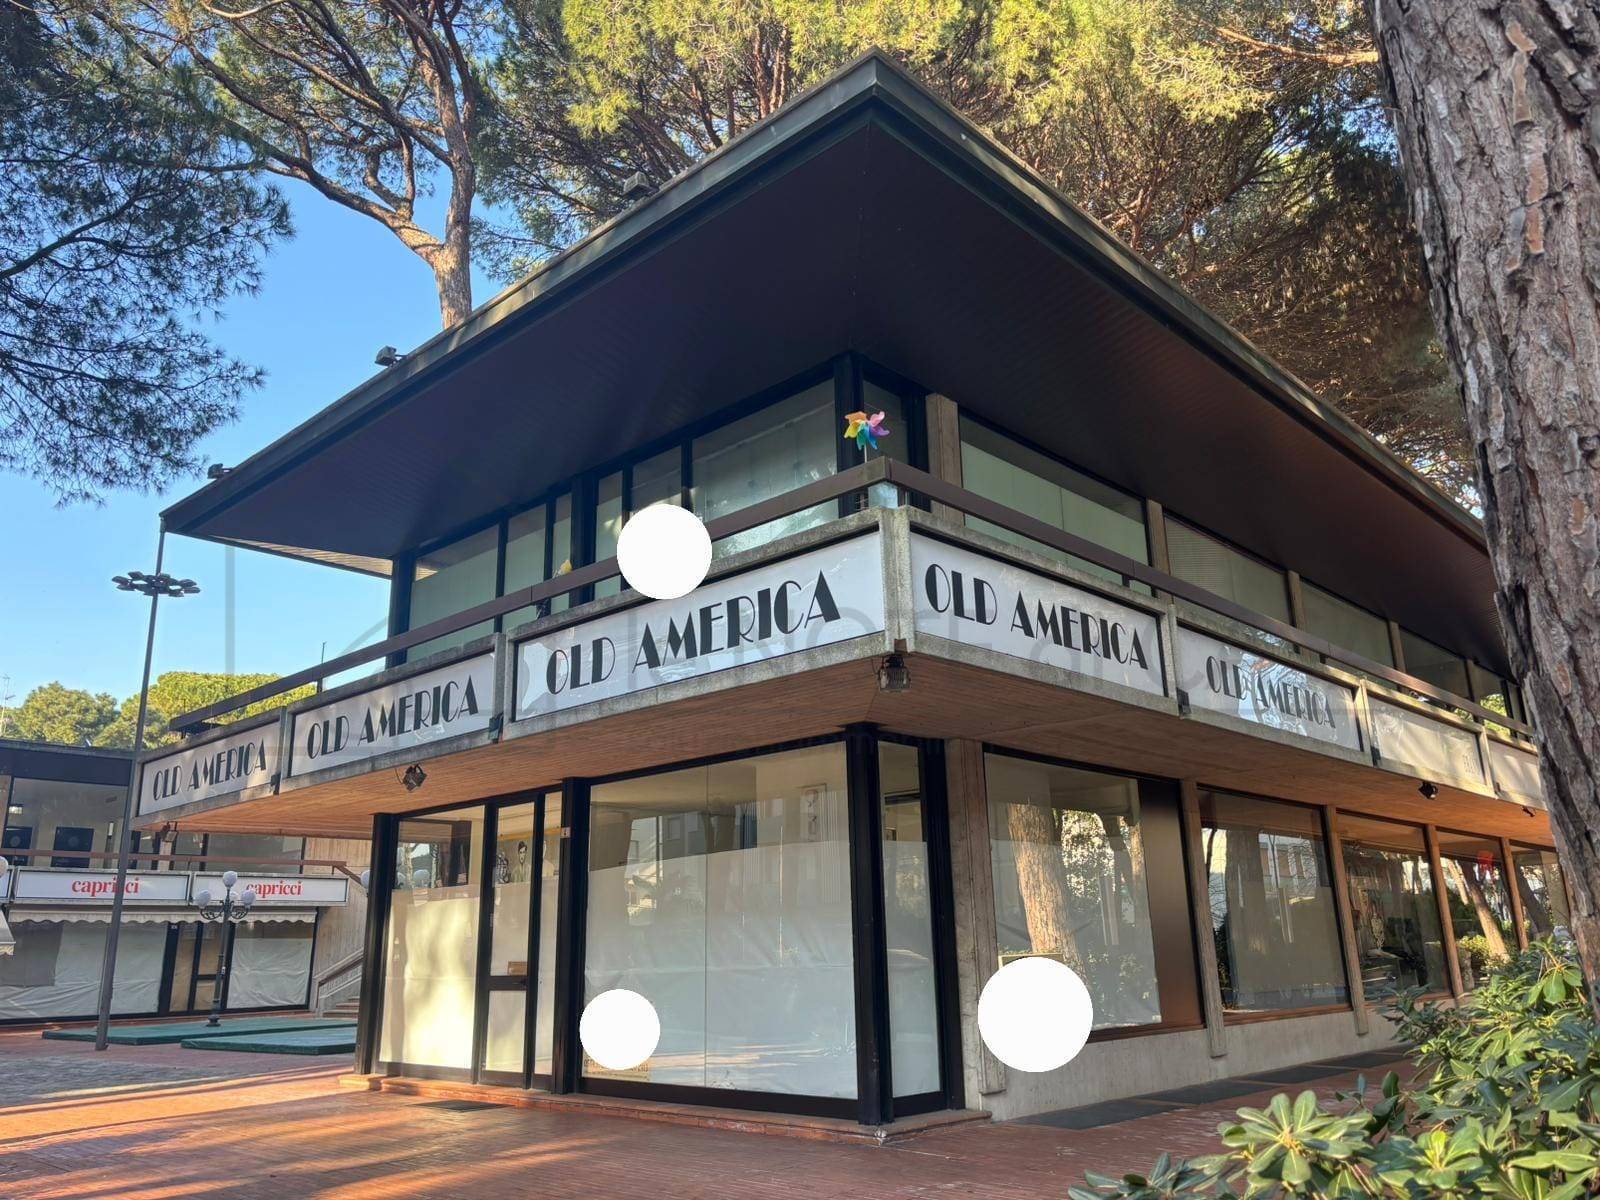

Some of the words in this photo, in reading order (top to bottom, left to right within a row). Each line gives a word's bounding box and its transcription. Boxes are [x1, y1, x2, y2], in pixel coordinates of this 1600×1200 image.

[546, 636, 616, 695] OLD
[632, 570, 841, 674] AMERICA
[925, 563, 998, 626] OLD
[1010, 591, 1148, 670] AMERICA
[307, 715, 350, 760] OLD
[358, 674, 479, 746] AMERICA
[1206, 655, 1252, 700] OLD
[1255, 671, 1336, 729] AMERICA
[153, 765, 182, 801] OLD
[187, 738, 267, 791] AMERICA
[71, 876, 140, 897] caprici
